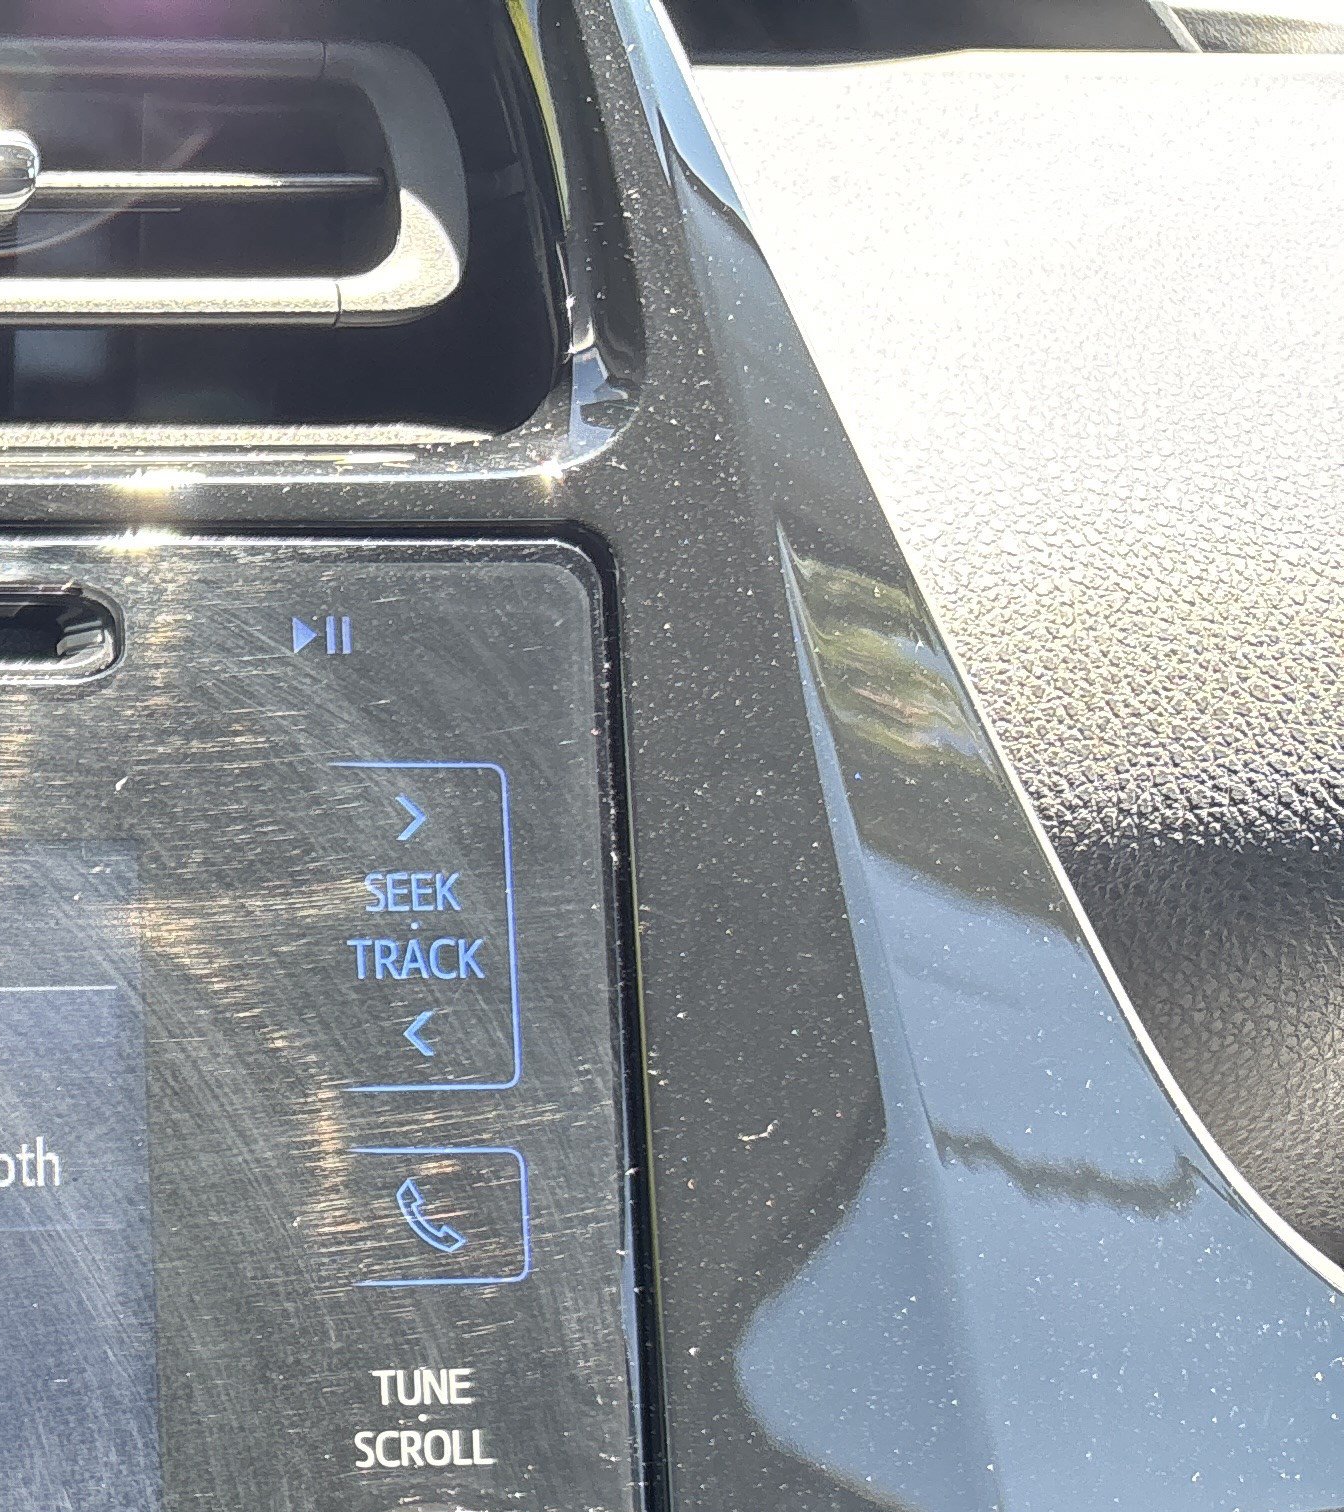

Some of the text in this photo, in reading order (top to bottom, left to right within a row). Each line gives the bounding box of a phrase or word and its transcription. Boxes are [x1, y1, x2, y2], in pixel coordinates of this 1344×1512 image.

[363, 872, 462, 913] SEEK
[346, 937, 487, 980] TRACK
[371, 1368, 472, 1405] TUNE
[354, 1429, 496, 1468] SCROLL
